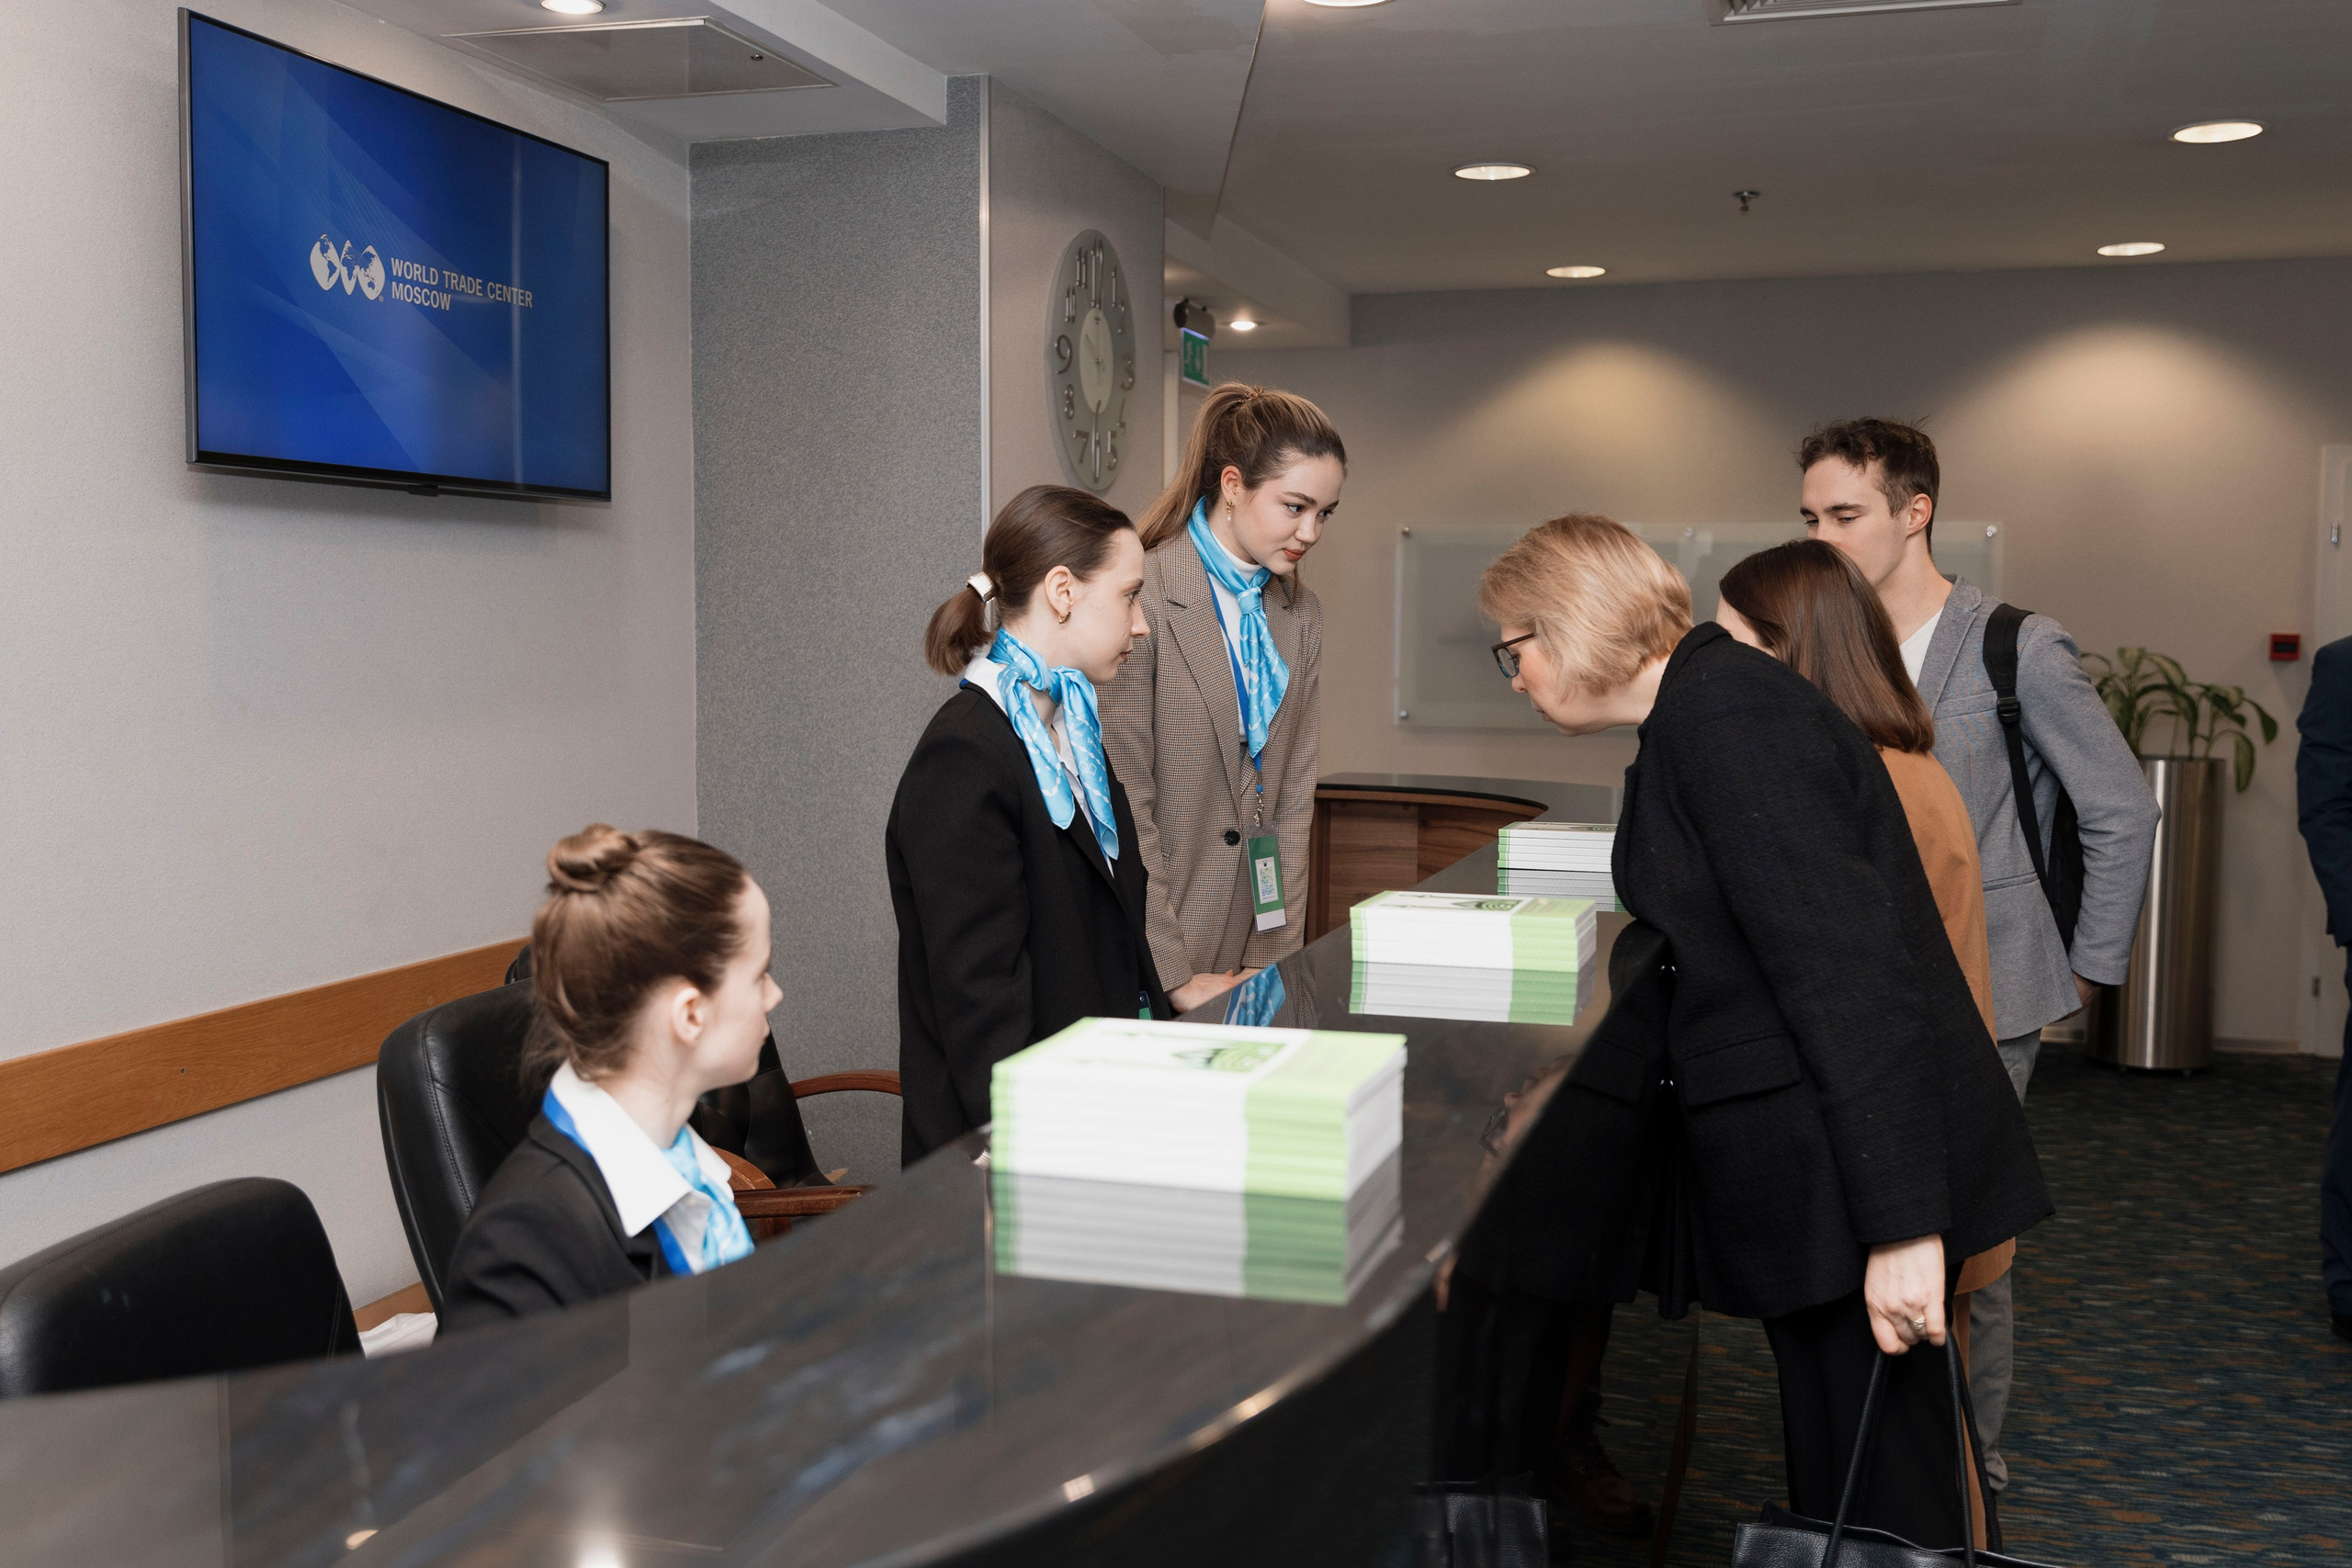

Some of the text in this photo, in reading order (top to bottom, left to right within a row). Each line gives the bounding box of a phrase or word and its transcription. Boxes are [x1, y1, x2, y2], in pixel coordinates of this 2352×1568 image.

[390, 257, 533, 309] WORLD TRADE CENTER
[391, 282, 452, 311] MOSCOW
[1054, 334, 1073, 374] 9
[1119, 352, 1136, 390] 3
[1064, 383, 1075, 420] 8
[1073, 430, 1090, 464] 7
[1105, 430, 1118, 470] 5
